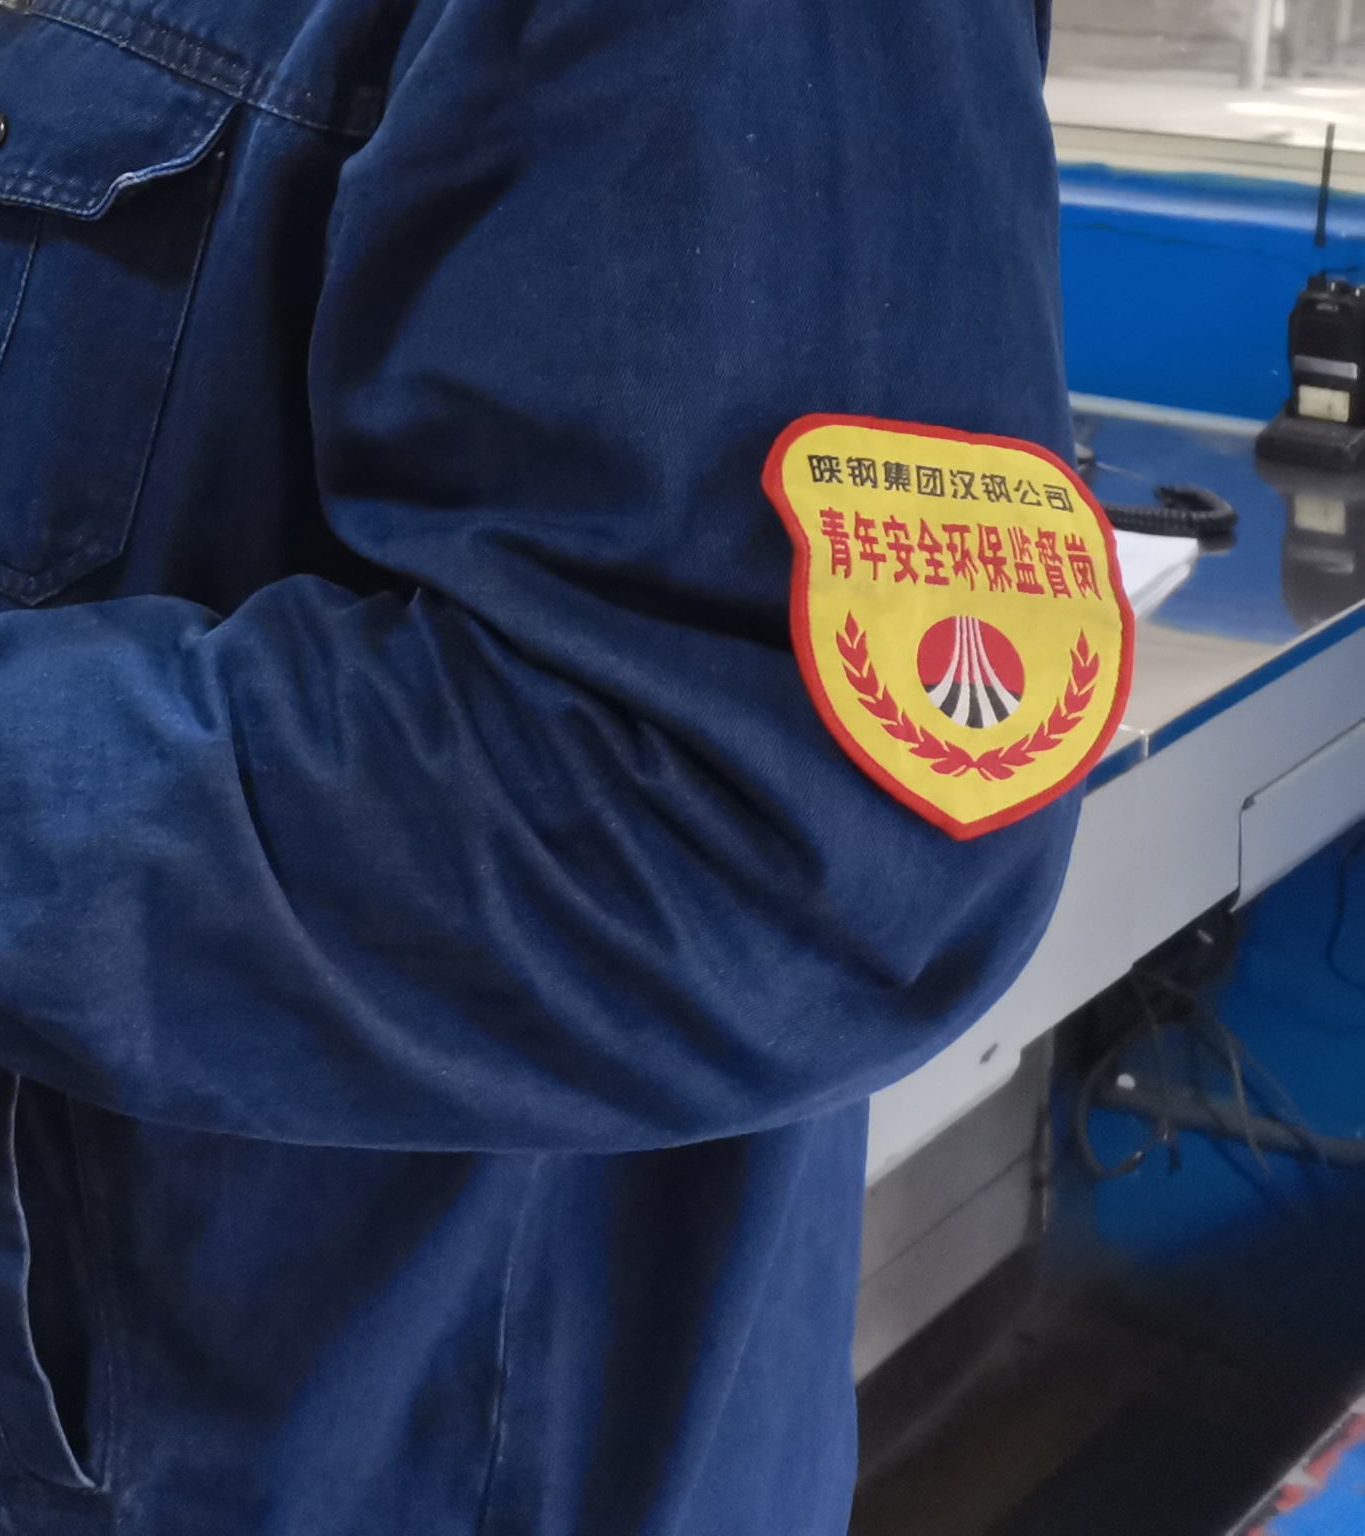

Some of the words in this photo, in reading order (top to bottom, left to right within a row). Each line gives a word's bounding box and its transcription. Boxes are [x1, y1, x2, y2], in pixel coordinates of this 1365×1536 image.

[807, 453, 1074, 514] 陕钢集团汉钢公司
[819, 506, 1104, 602] 青年安全环保监督岗
